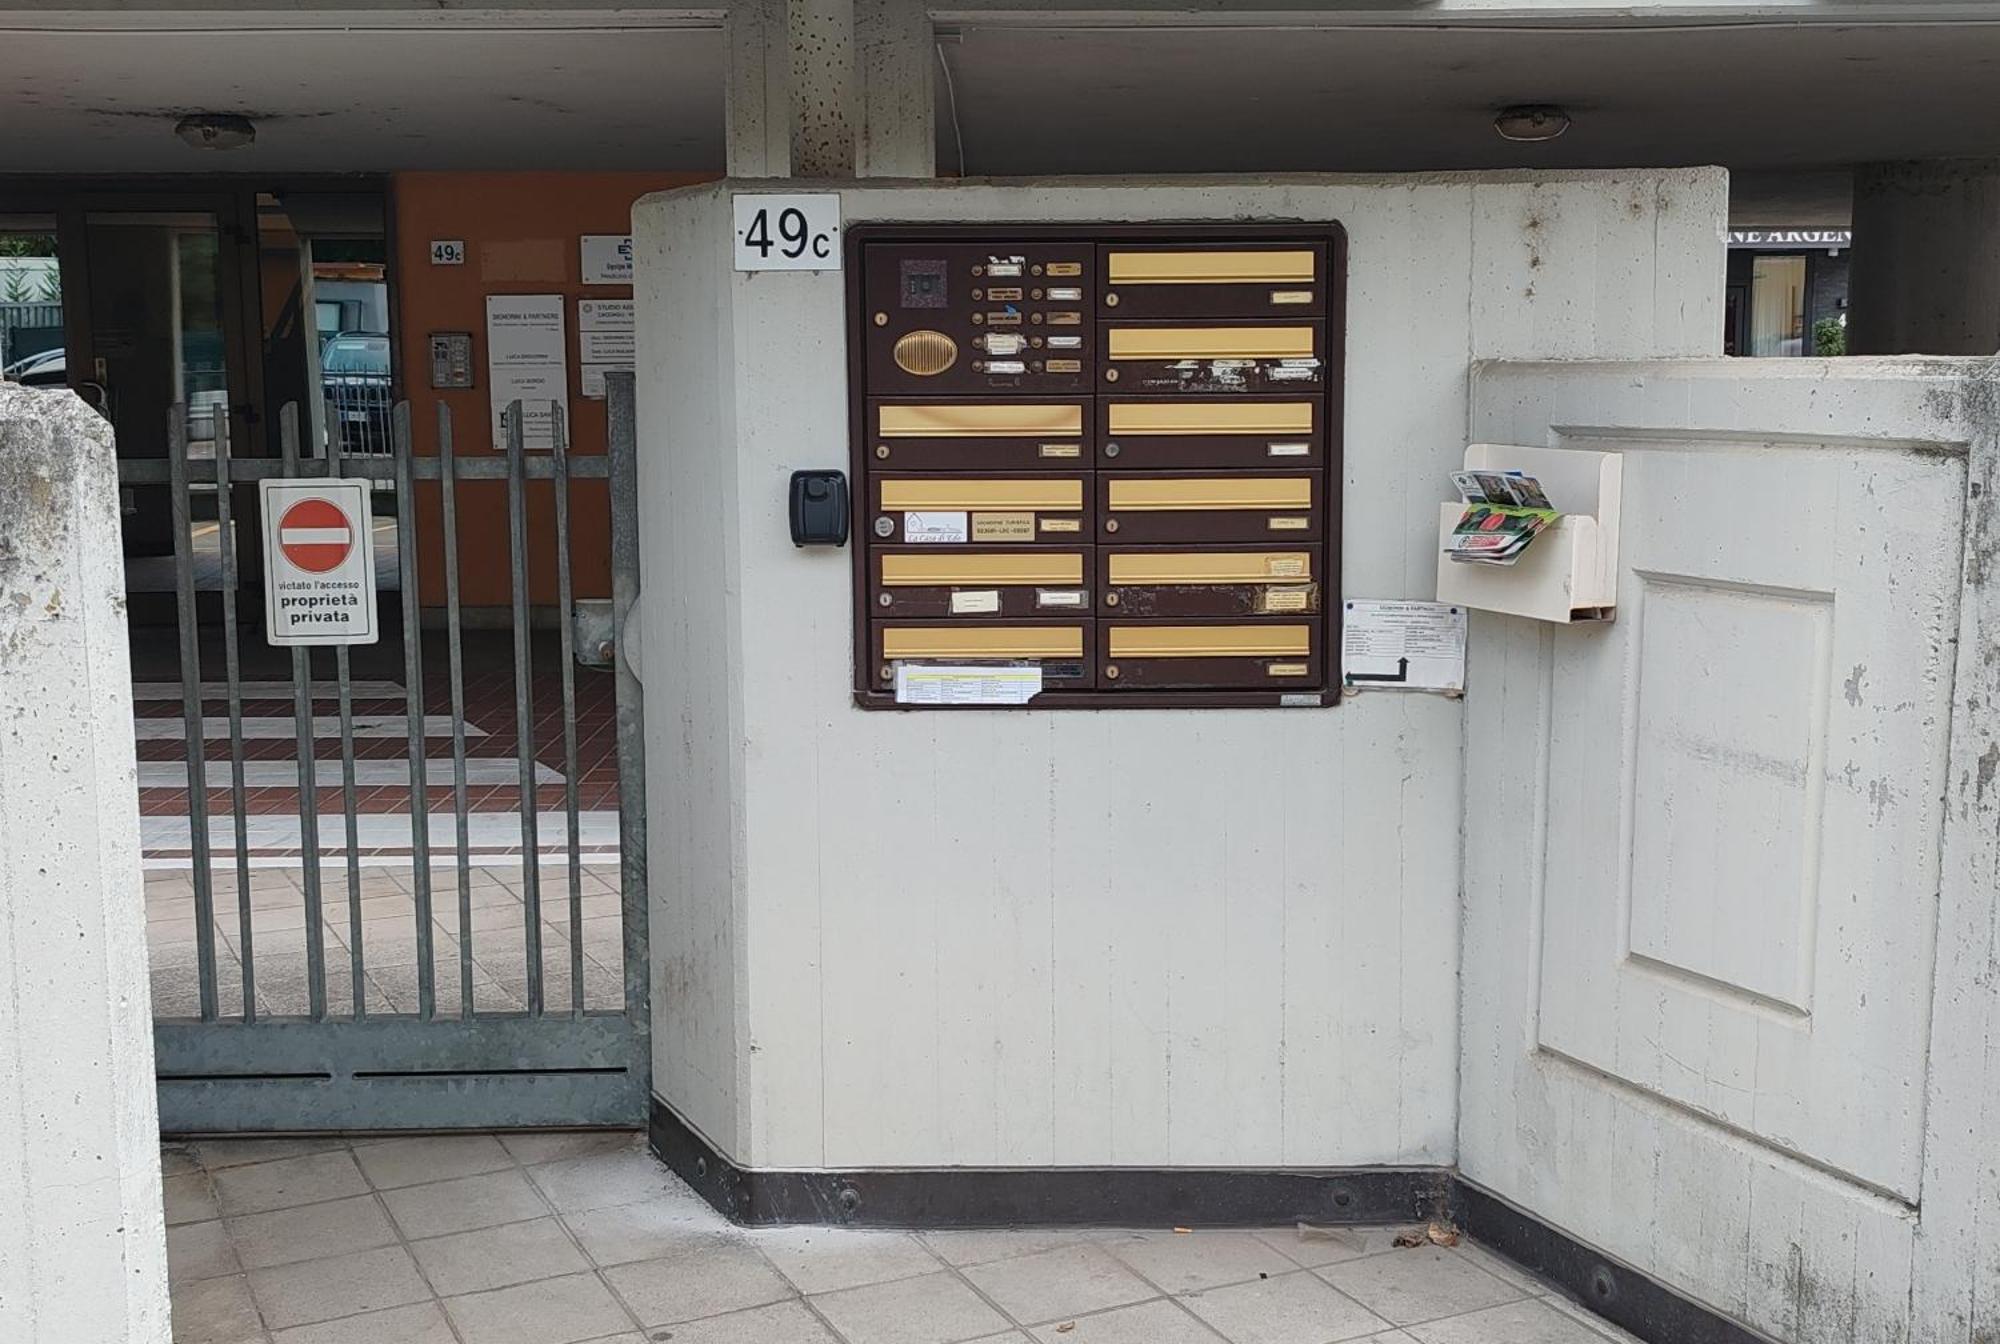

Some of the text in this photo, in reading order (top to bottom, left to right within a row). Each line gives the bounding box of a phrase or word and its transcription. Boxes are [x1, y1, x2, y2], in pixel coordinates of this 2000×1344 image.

[745, 207, 830, 258] 49c
[434, 245, 461, 261] 49c
[281, 594, 358, 609] proprietà
[291, 610, 350, 625] privata
